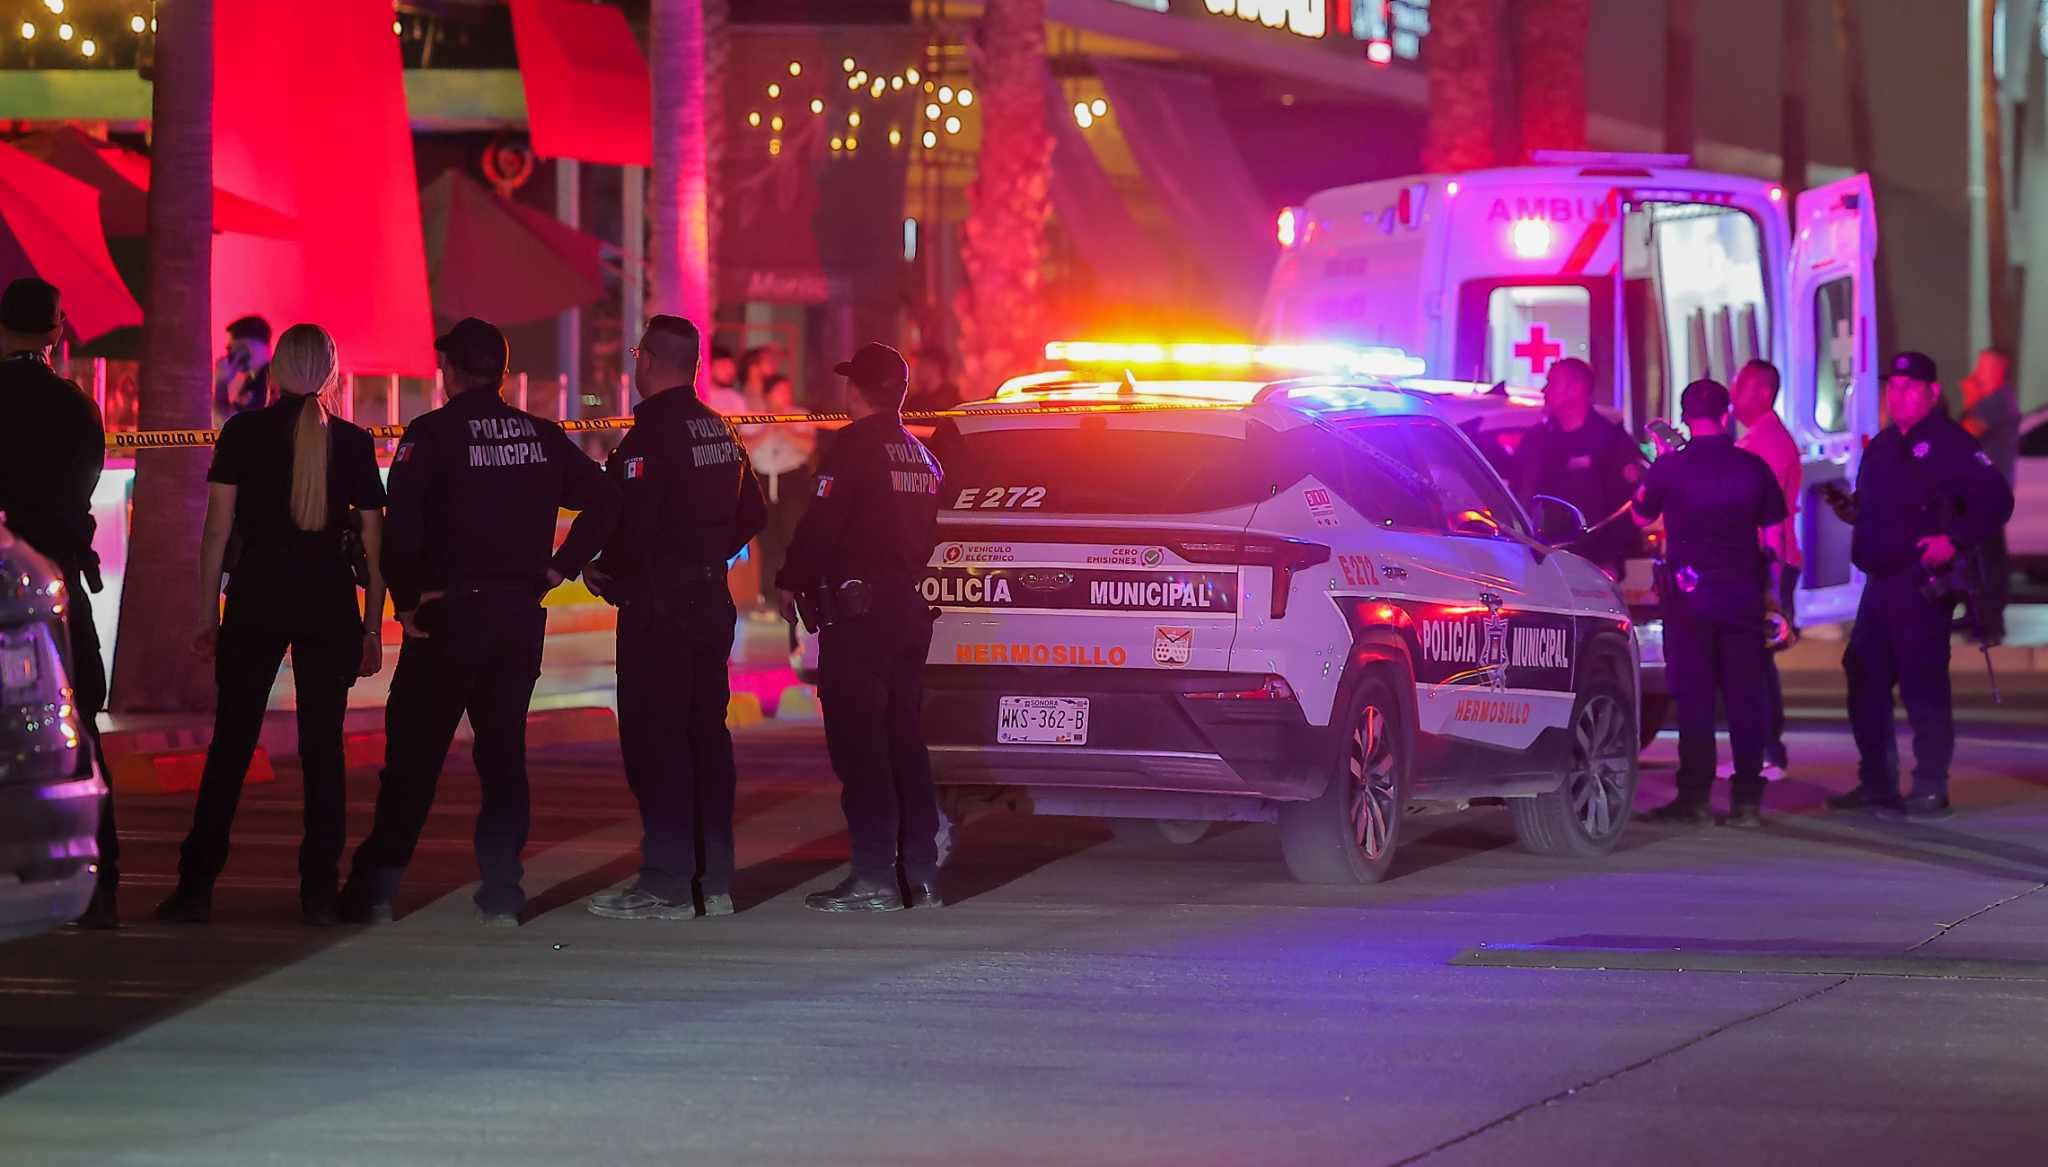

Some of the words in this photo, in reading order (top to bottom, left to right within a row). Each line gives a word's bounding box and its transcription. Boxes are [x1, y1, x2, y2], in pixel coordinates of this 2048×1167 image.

[468, 442, 548, 467] MUNICIPAL
[1087, 556, 1137, 565] EMISIONES
[1112, 548, 1138, 556] CERO
[915, 575, 1012, 602] OLICÍA
[1090, 581, 1211, 607] MUNICIPAL
[955, 642, 1127, 666] HERMOSILLO
[1423, 616, 1477, 662] POLICÍA
[1512, 626, 1569, 668] MUNICIPAL
[1001, 708, 1085, 730] WKS-362-B
[1456, 700, 1531, 724] HERMOSILLO
